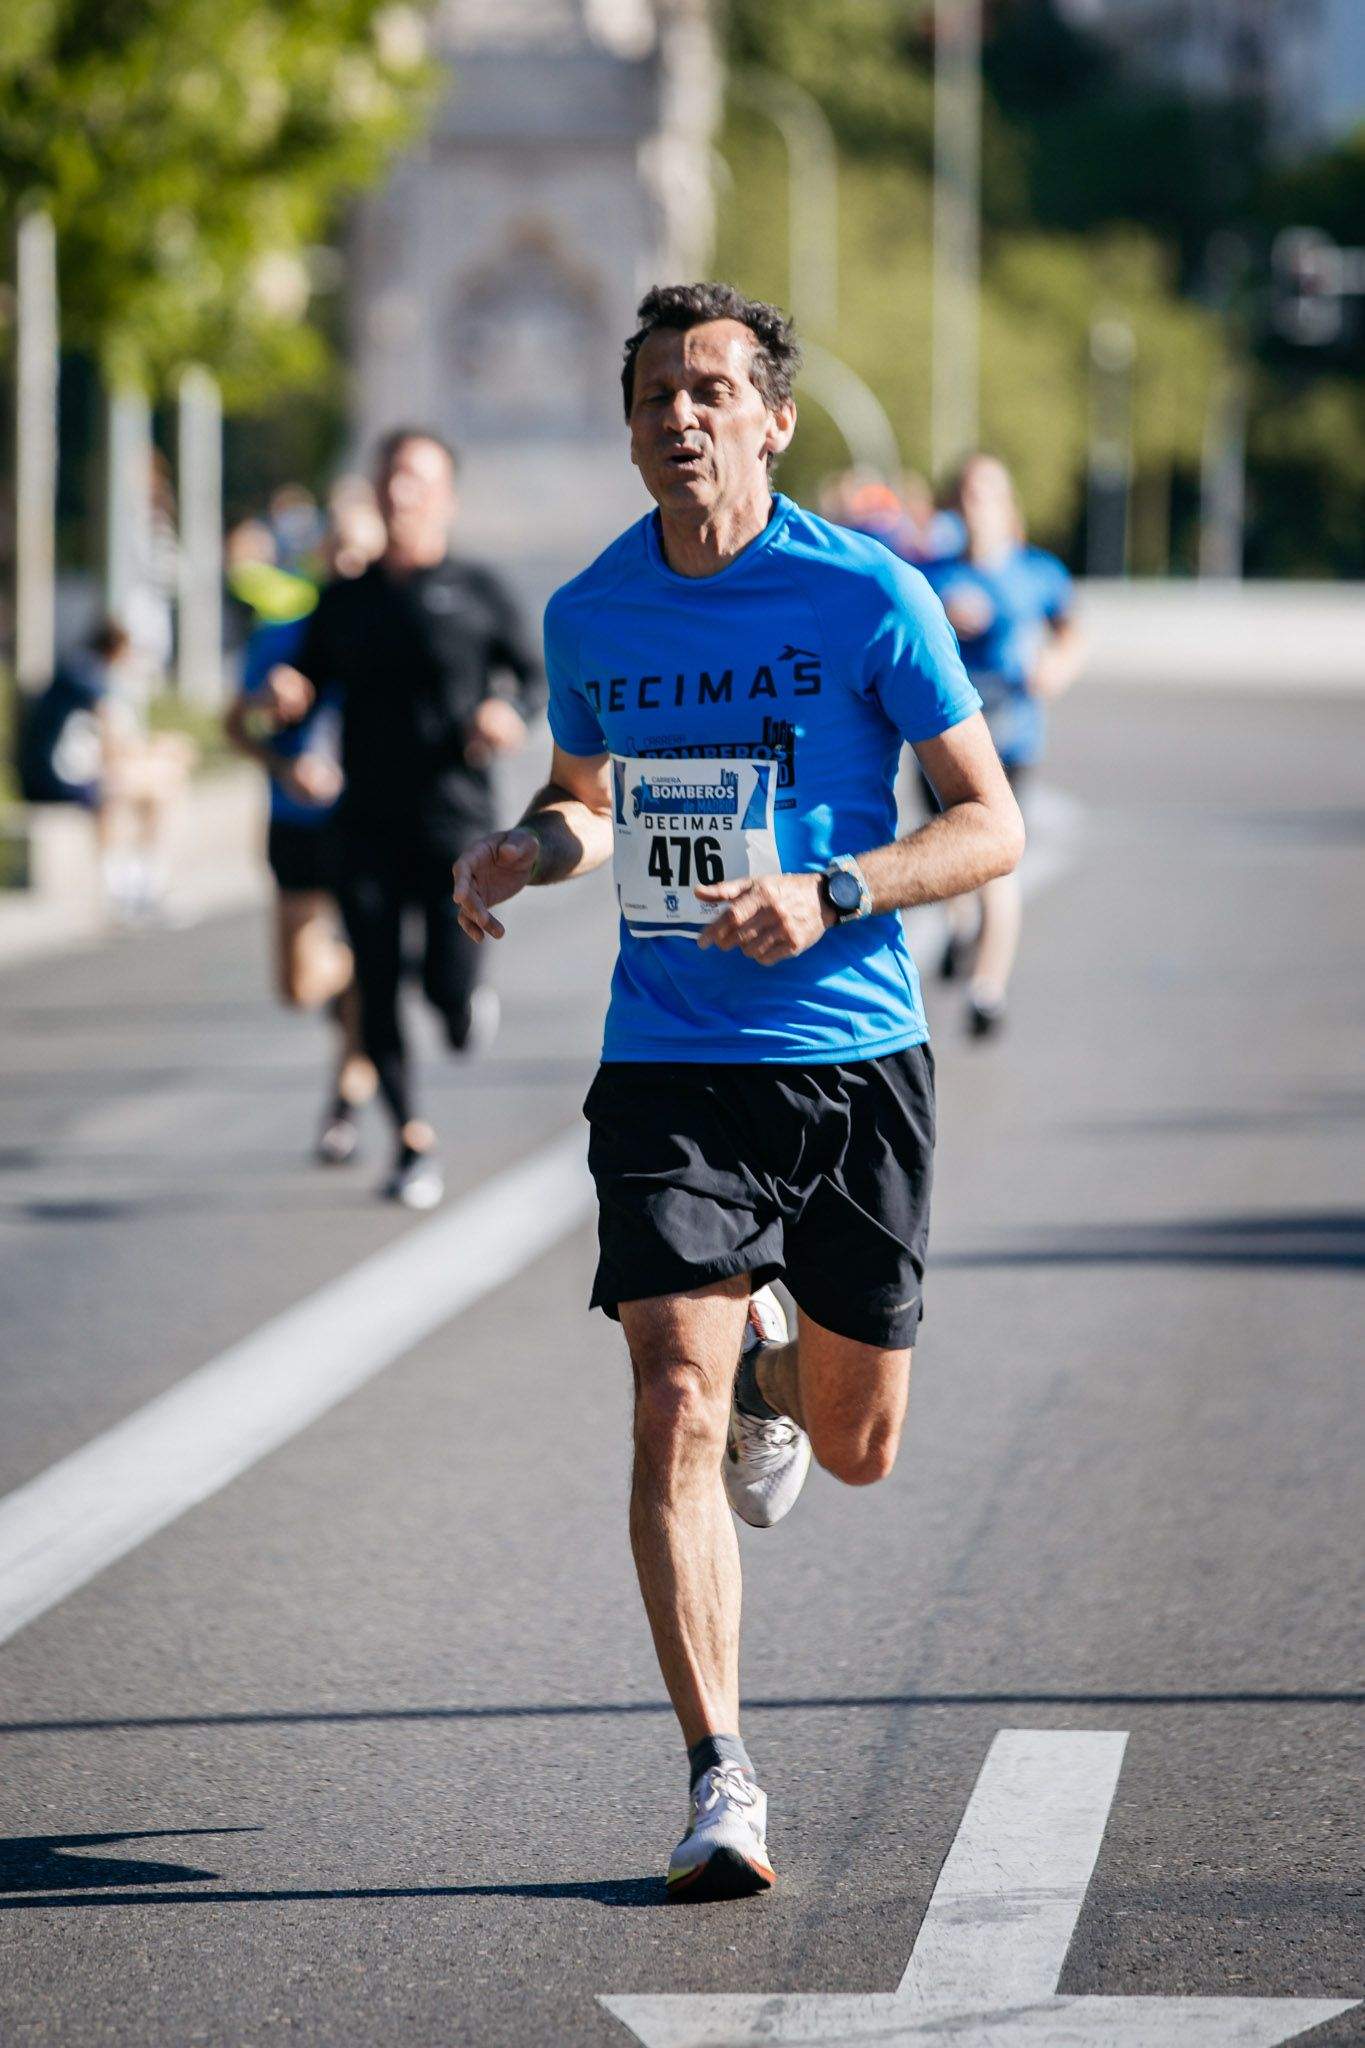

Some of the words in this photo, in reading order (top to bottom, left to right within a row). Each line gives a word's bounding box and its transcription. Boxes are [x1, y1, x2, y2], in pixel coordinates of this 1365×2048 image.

[651, 776, 682, 784] CARRERA
[651, 785, 735, 800] BOMBEROS
[645, 815, 733, 831] DECIMAS
[648, 835, 725, 887] 476
